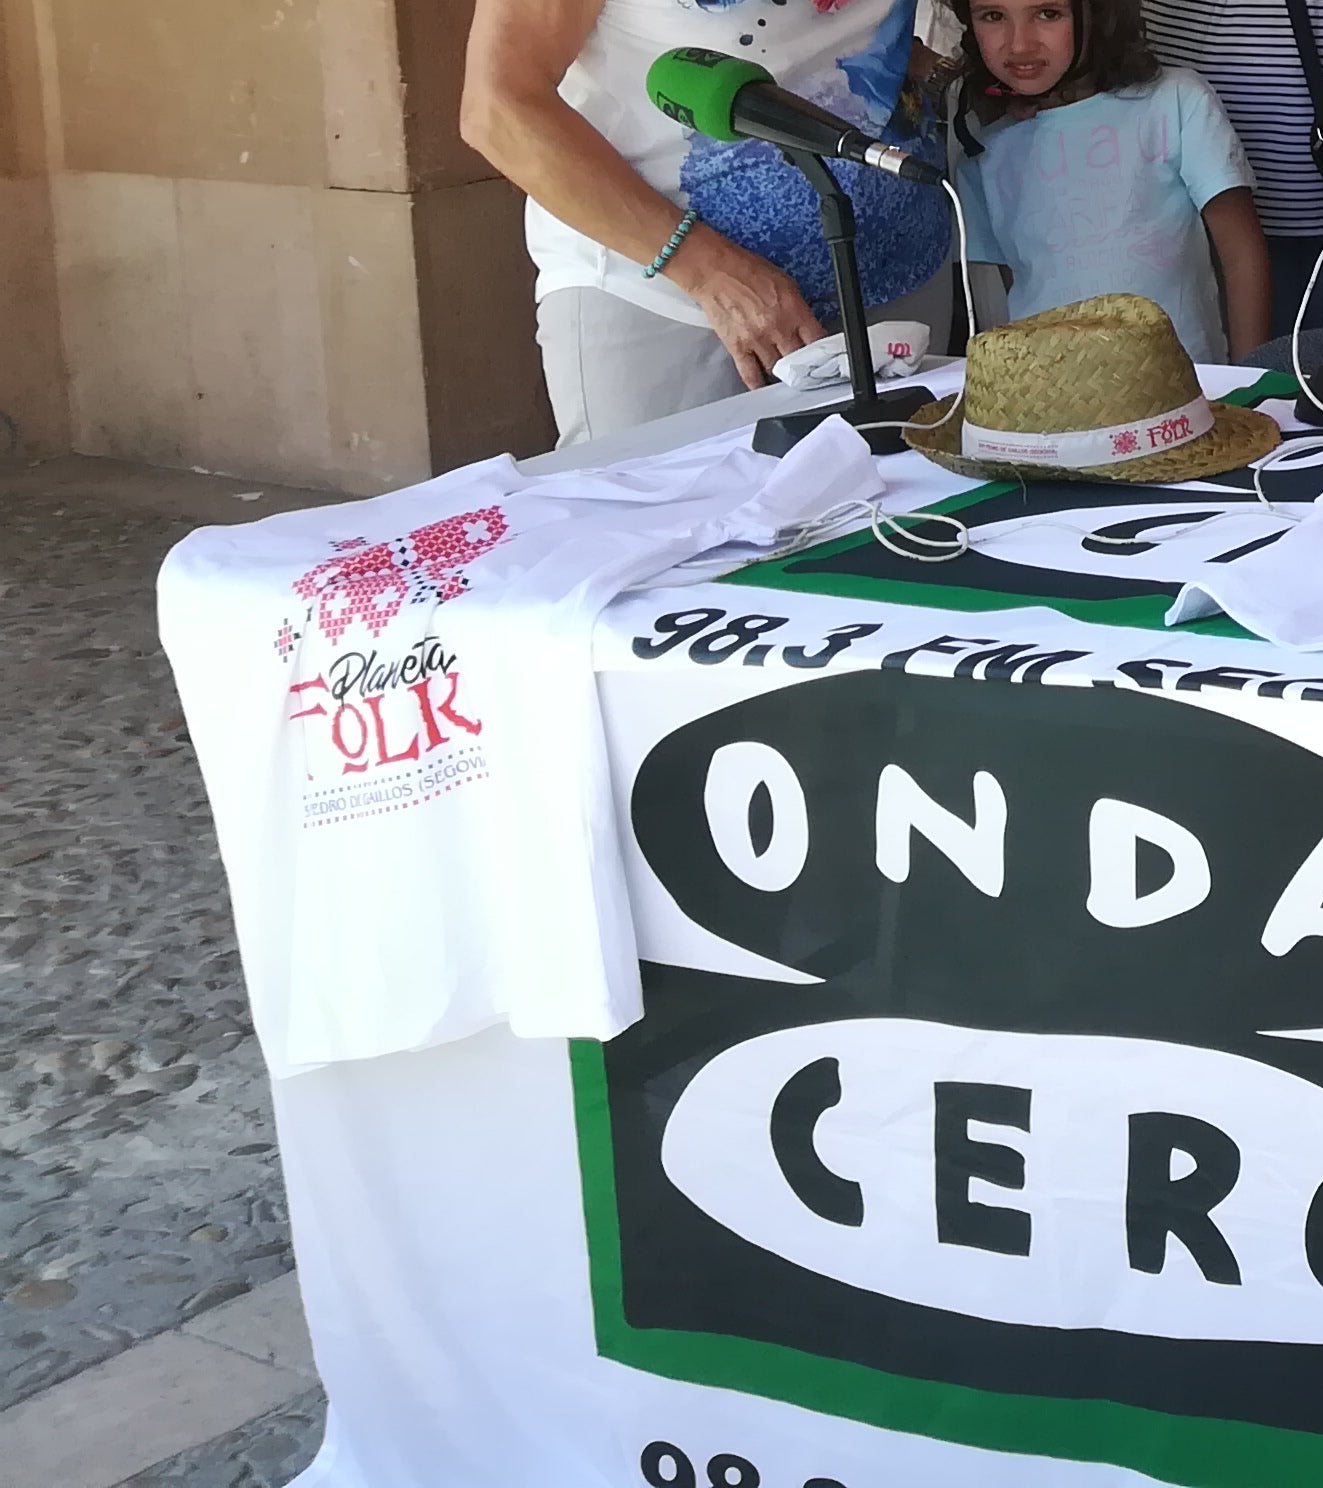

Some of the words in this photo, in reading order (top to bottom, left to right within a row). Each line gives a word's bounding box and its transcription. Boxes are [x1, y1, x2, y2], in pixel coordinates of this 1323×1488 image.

[1147, 420, 1194, 448] FOLK
[328, 635, 457, 707] Planeta
[631, 607, 884, 668] 98.3
[881, 634, 1095, 688] FM
